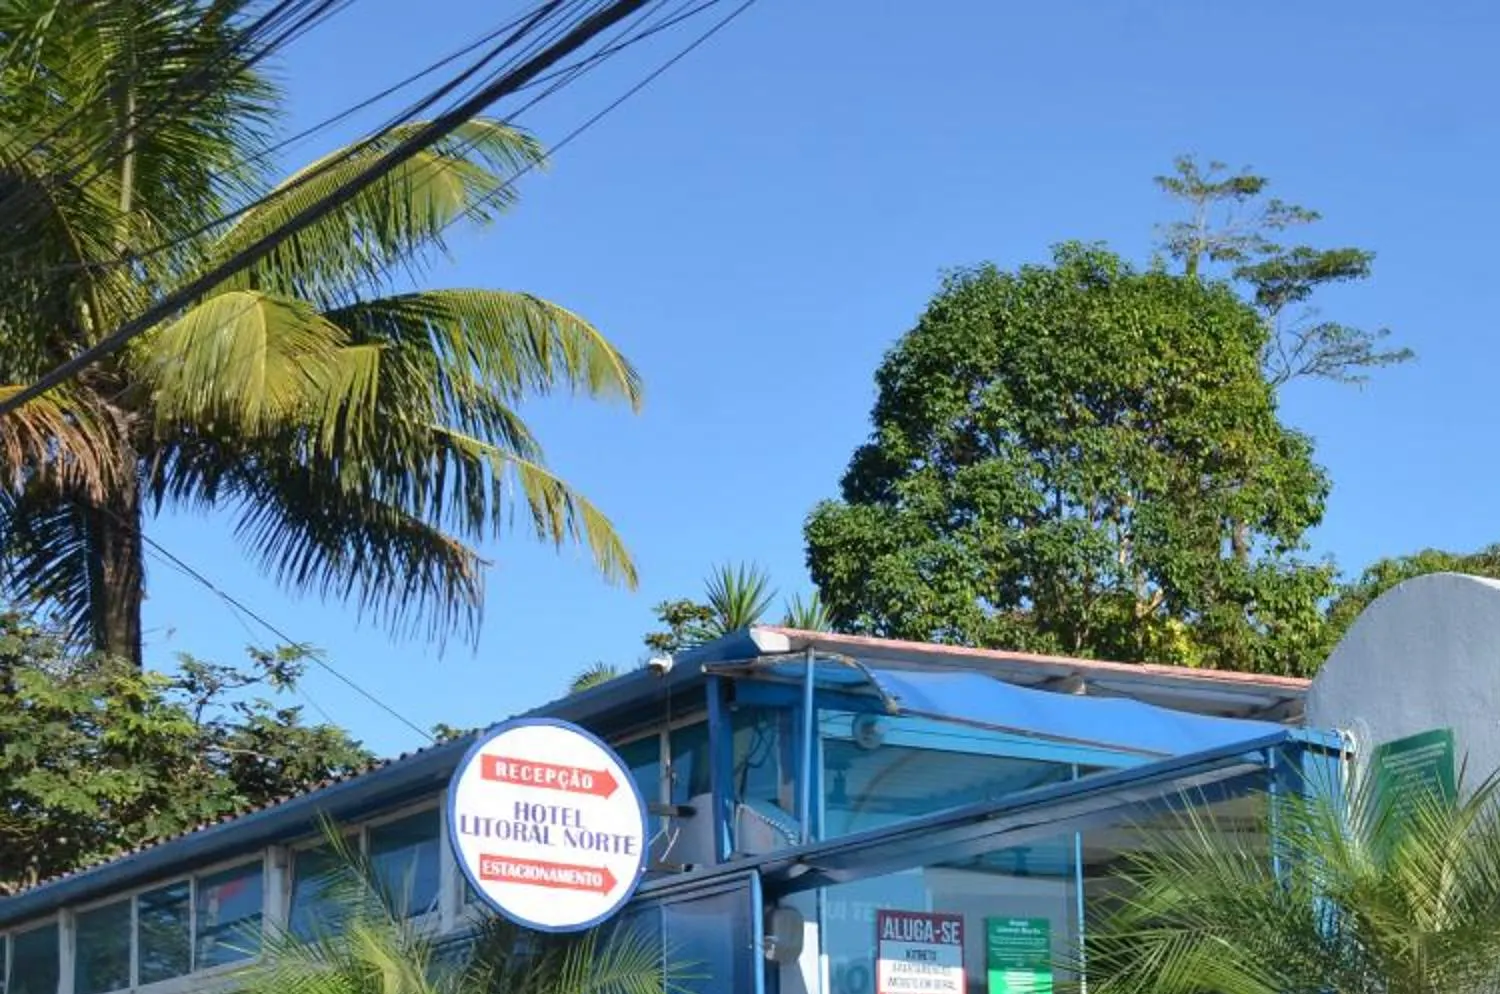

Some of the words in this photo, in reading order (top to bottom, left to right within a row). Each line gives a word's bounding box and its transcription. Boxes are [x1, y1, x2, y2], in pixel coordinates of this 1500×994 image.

[495, 760, 593, 790] RECEPÇÃO
[513, 800, 587, 829] HOTEL
[460, 813, 555, 846] LITORAL
[563, 828, 637, 857] NORTE
[482, 860, 604, 887] ESTACIONAMENTO
[882, 916, 961, 944] ALUGA-SE
